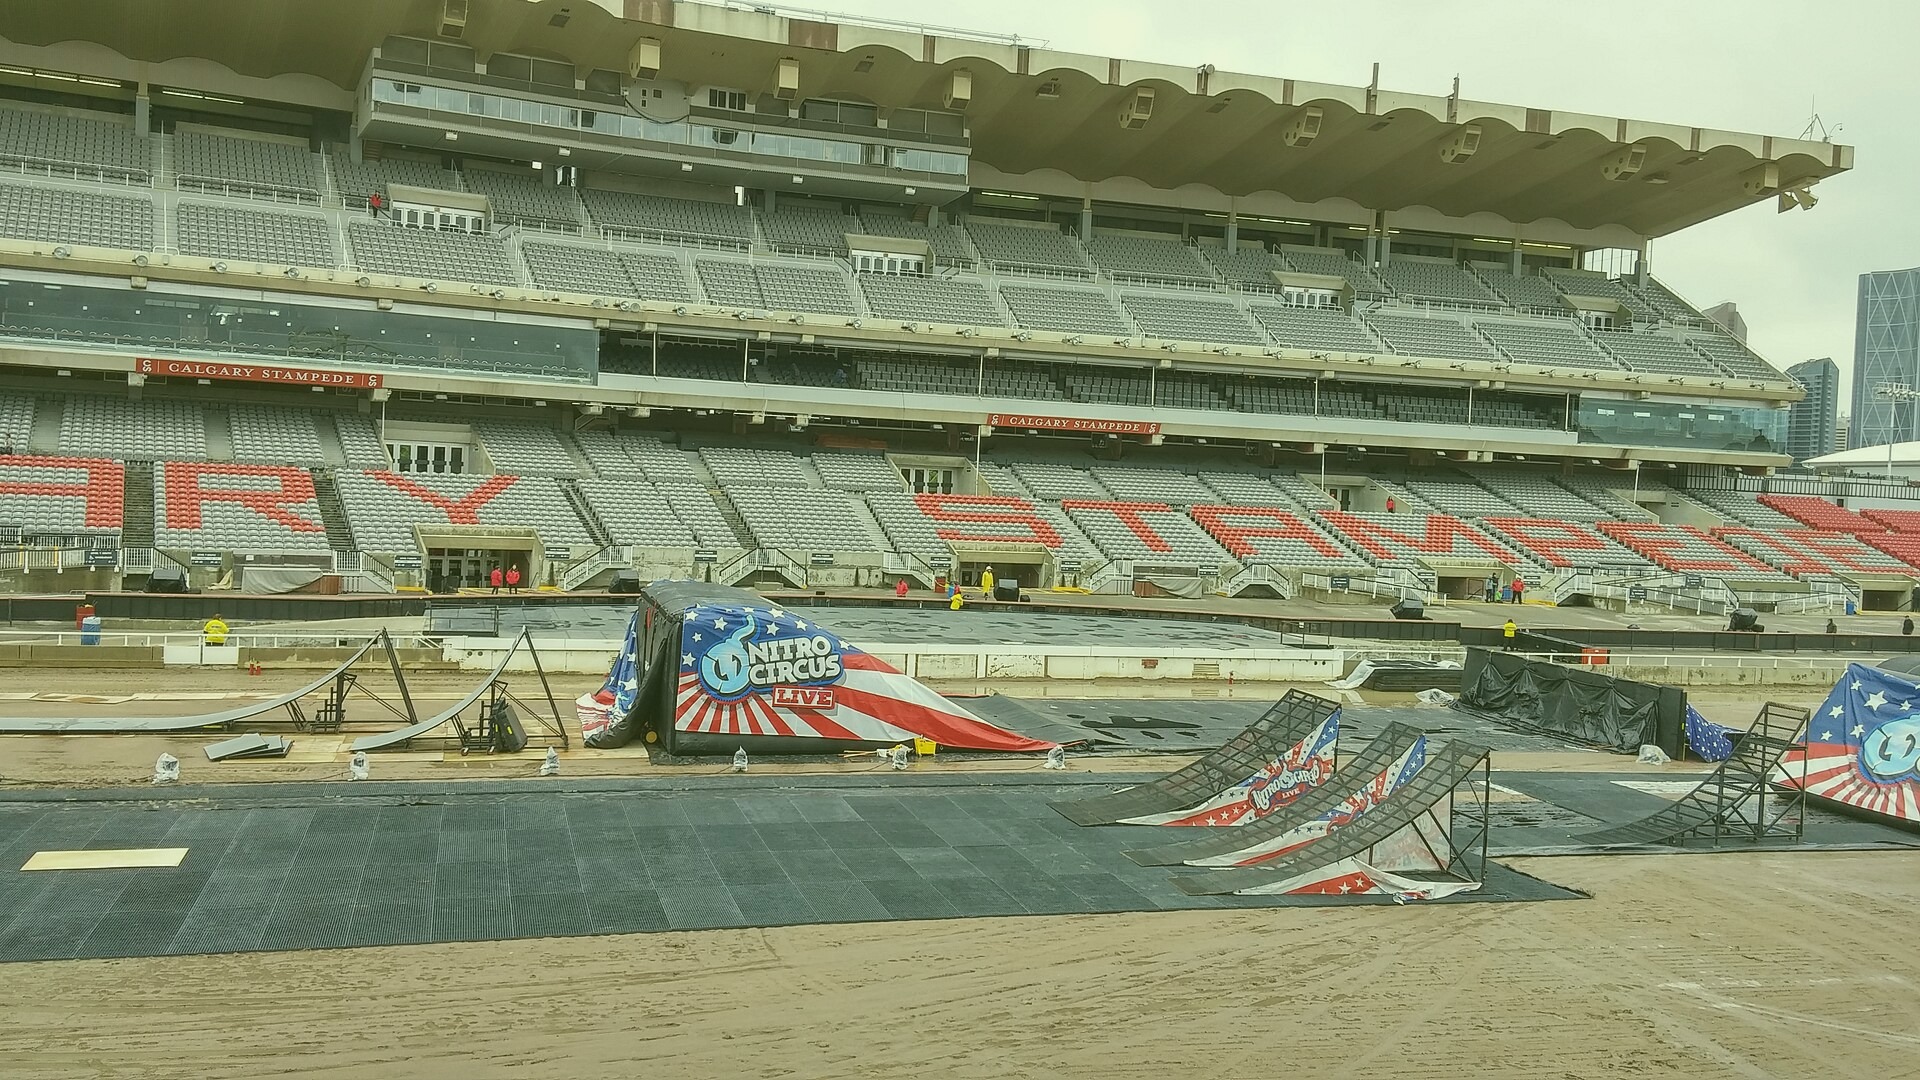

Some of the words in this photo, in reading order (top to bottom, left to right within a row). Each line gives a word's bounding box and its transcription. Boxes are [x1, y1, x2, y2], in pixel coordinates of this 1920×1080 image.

[168, 363, 254, 378] CALGARY
[262, 369, 355, 384] STAMPEDE
[1009, 416, 1070, 428] CALGARY
[1073, 420, 1141, 432] STAMPEDE
[748, 635, 832, 665] NITRO
[748, 654, 841, 685] CIRCUS
[777, 689, 832, 706] LIVE
[1281, 788, 1300, 799] LIVE
